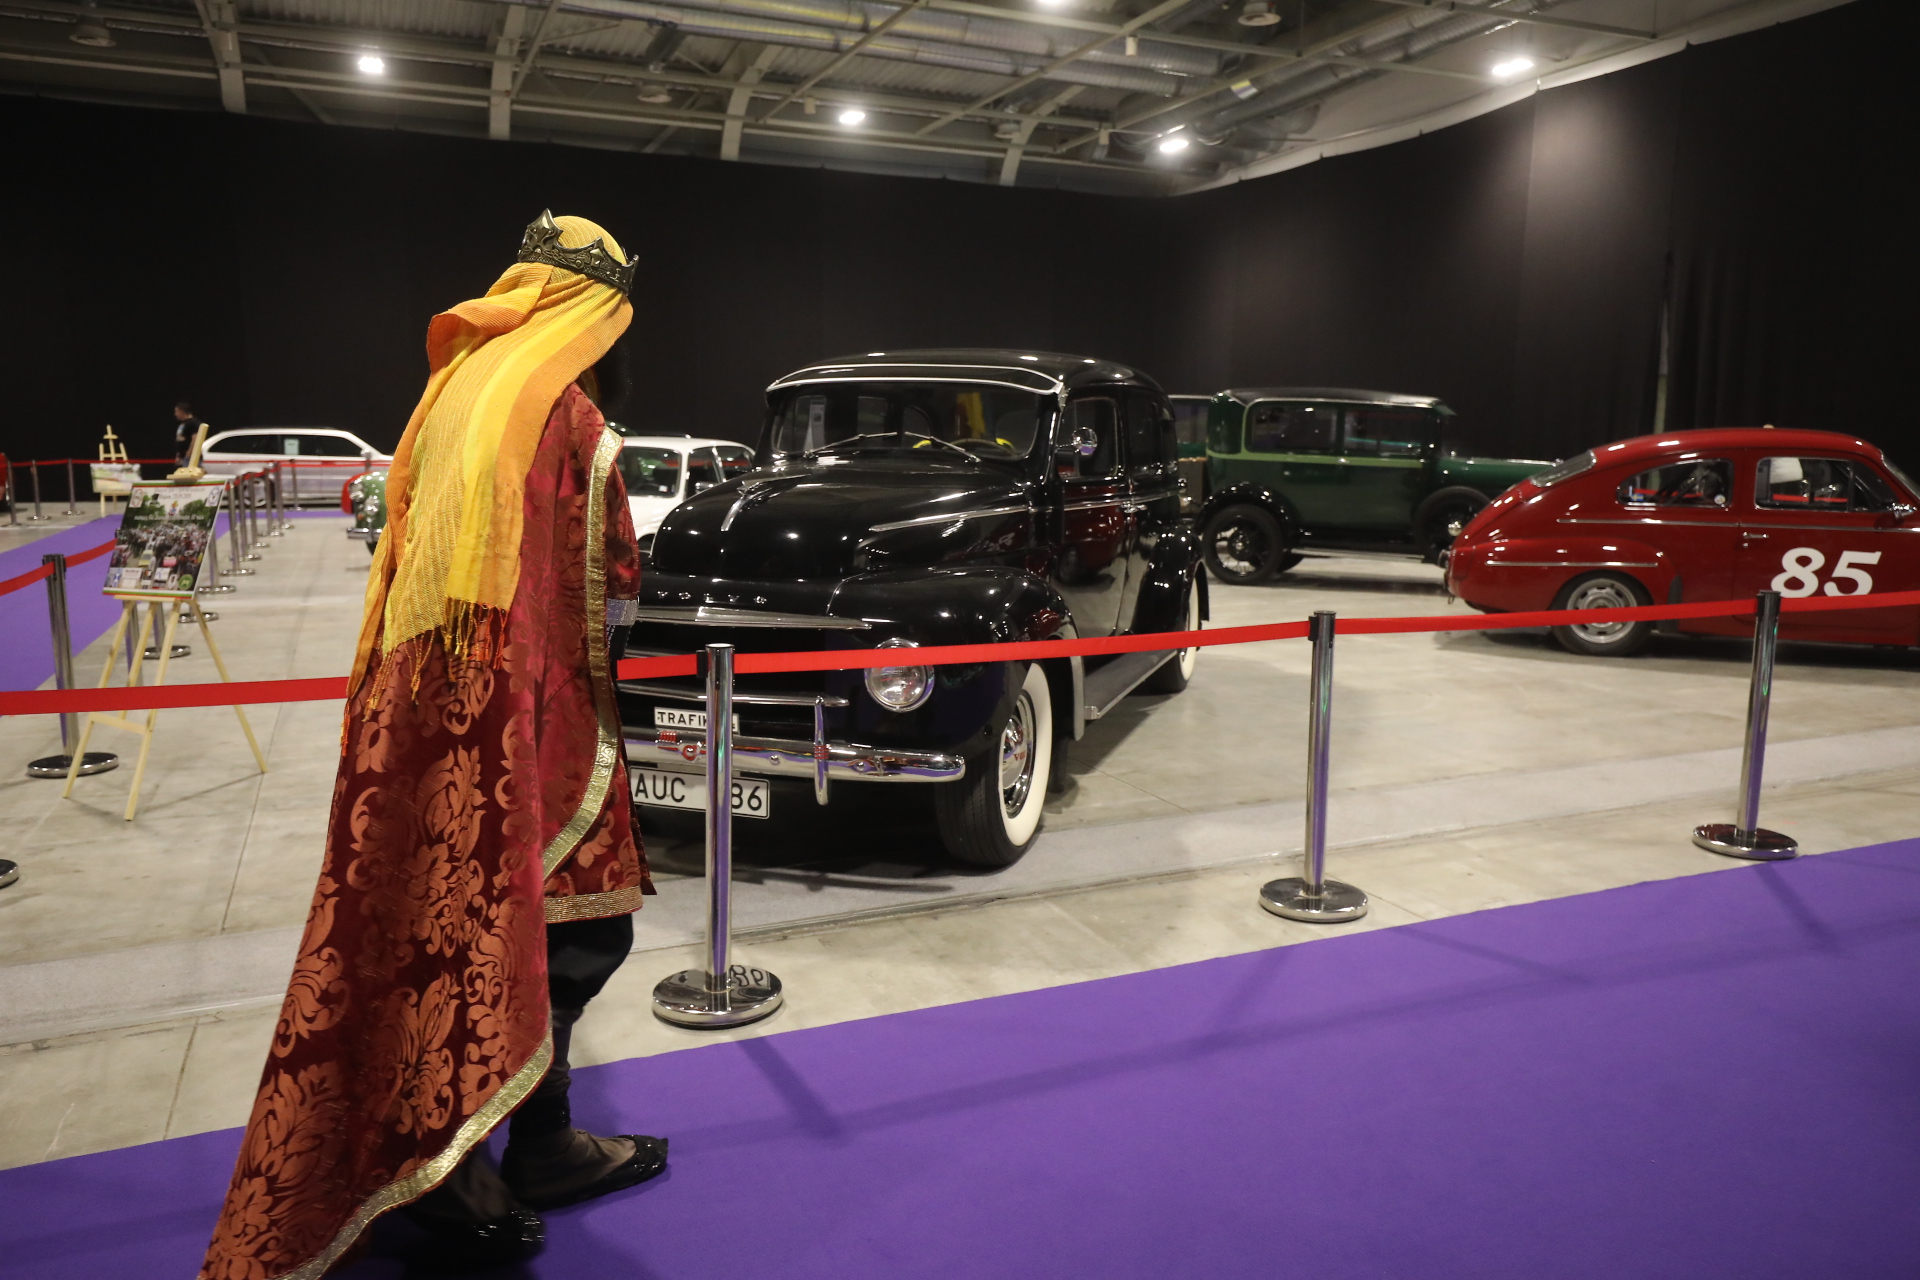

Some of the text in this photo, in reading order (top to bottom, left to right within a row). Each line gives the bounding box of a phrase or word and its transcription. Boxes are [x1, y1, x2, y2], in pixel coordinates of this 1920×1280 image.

[1770, 546, 1882, 599] 85
[657, 590, 768, 604] VOLVO
[634, 773, 762, 811] AUC 86
